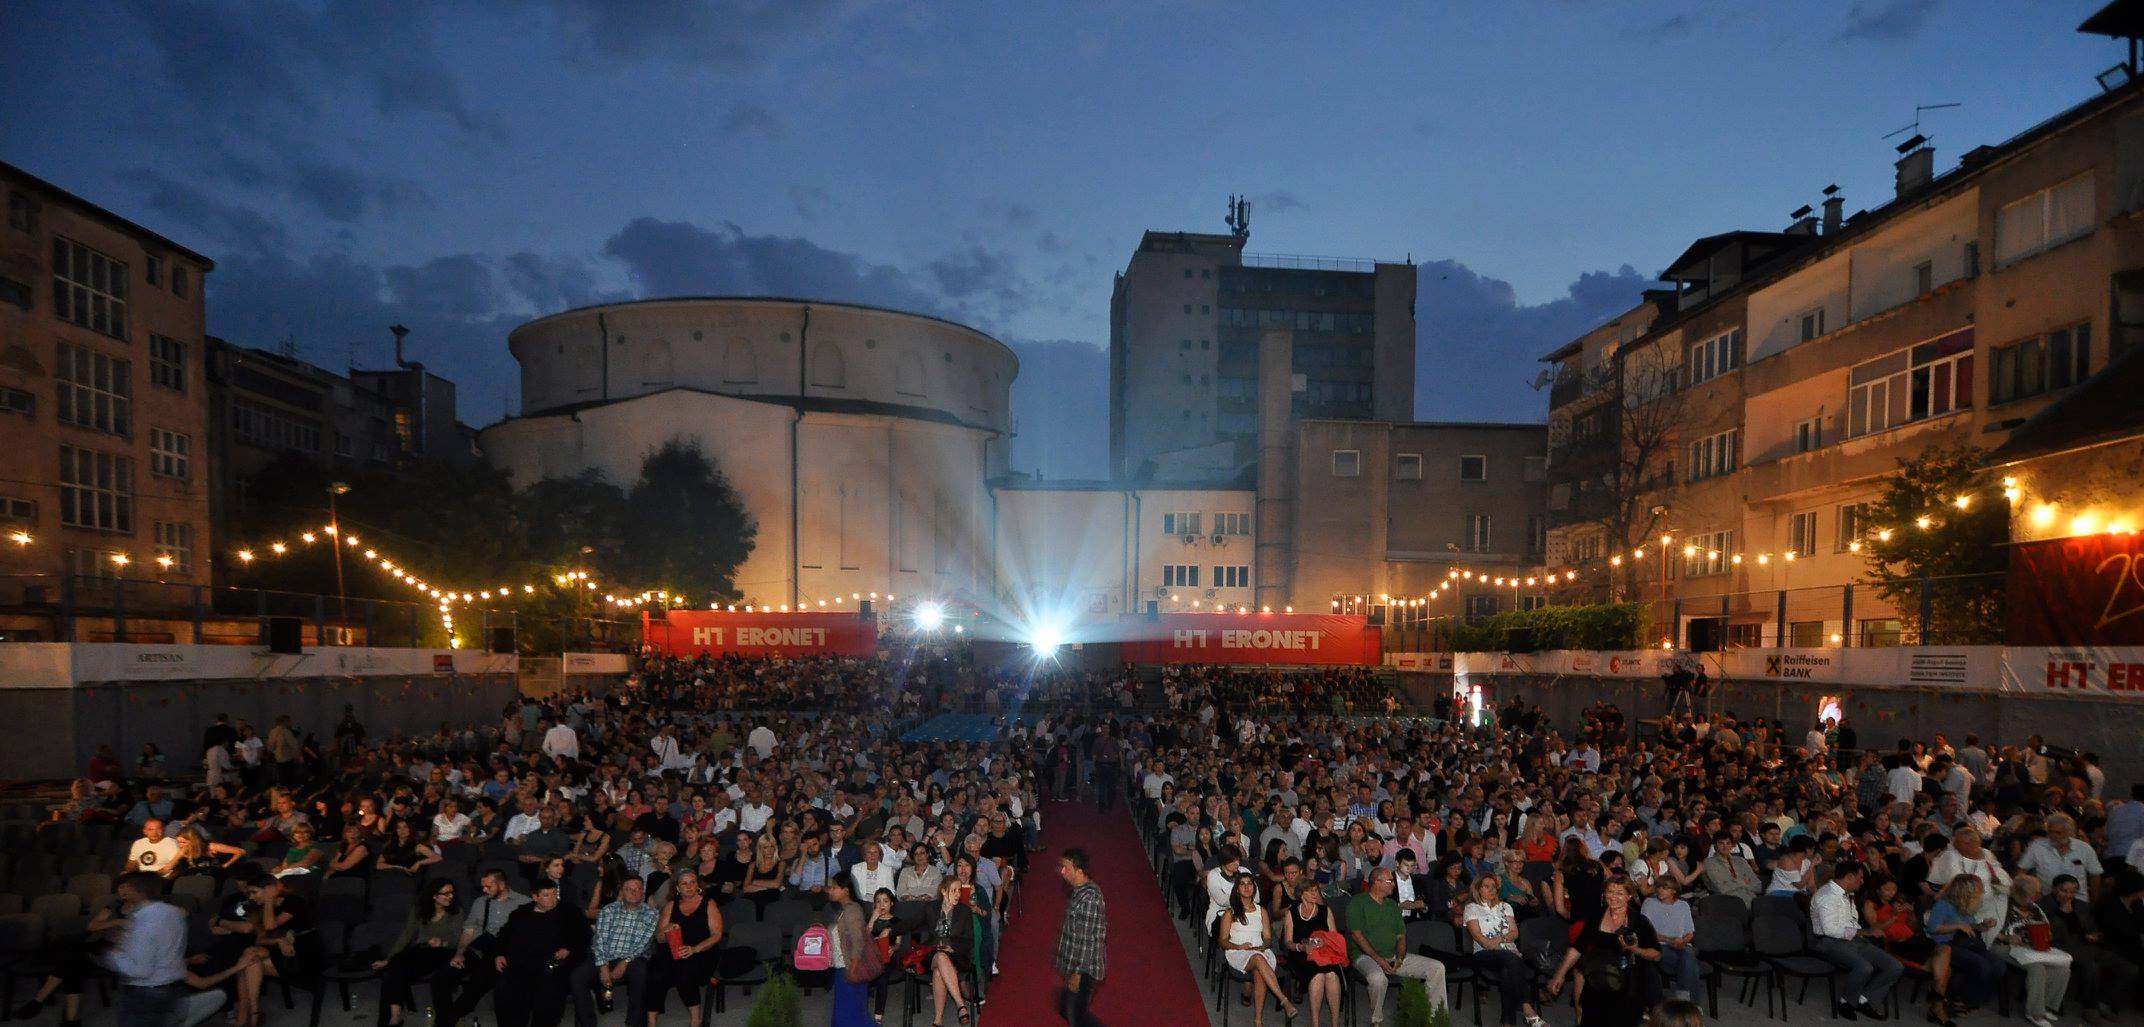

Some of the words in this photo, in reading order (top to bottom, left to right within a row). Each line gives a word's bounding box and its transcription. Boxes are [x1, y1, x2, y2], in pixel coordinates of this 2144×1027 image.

[693, 627, 723, 645] HT
[736, 627, 826, 646] ERONET
[1174, 630, 1207, 648] HT
[1222, 630, 1320, 649] ERONET
[137, 653, 184, 662] ARTISAN
[1784, 655, 1830, 666] Raiffeisen
[1783, 668, 1812, 678] BANK
[2047, 662, 2087, 688] HT
